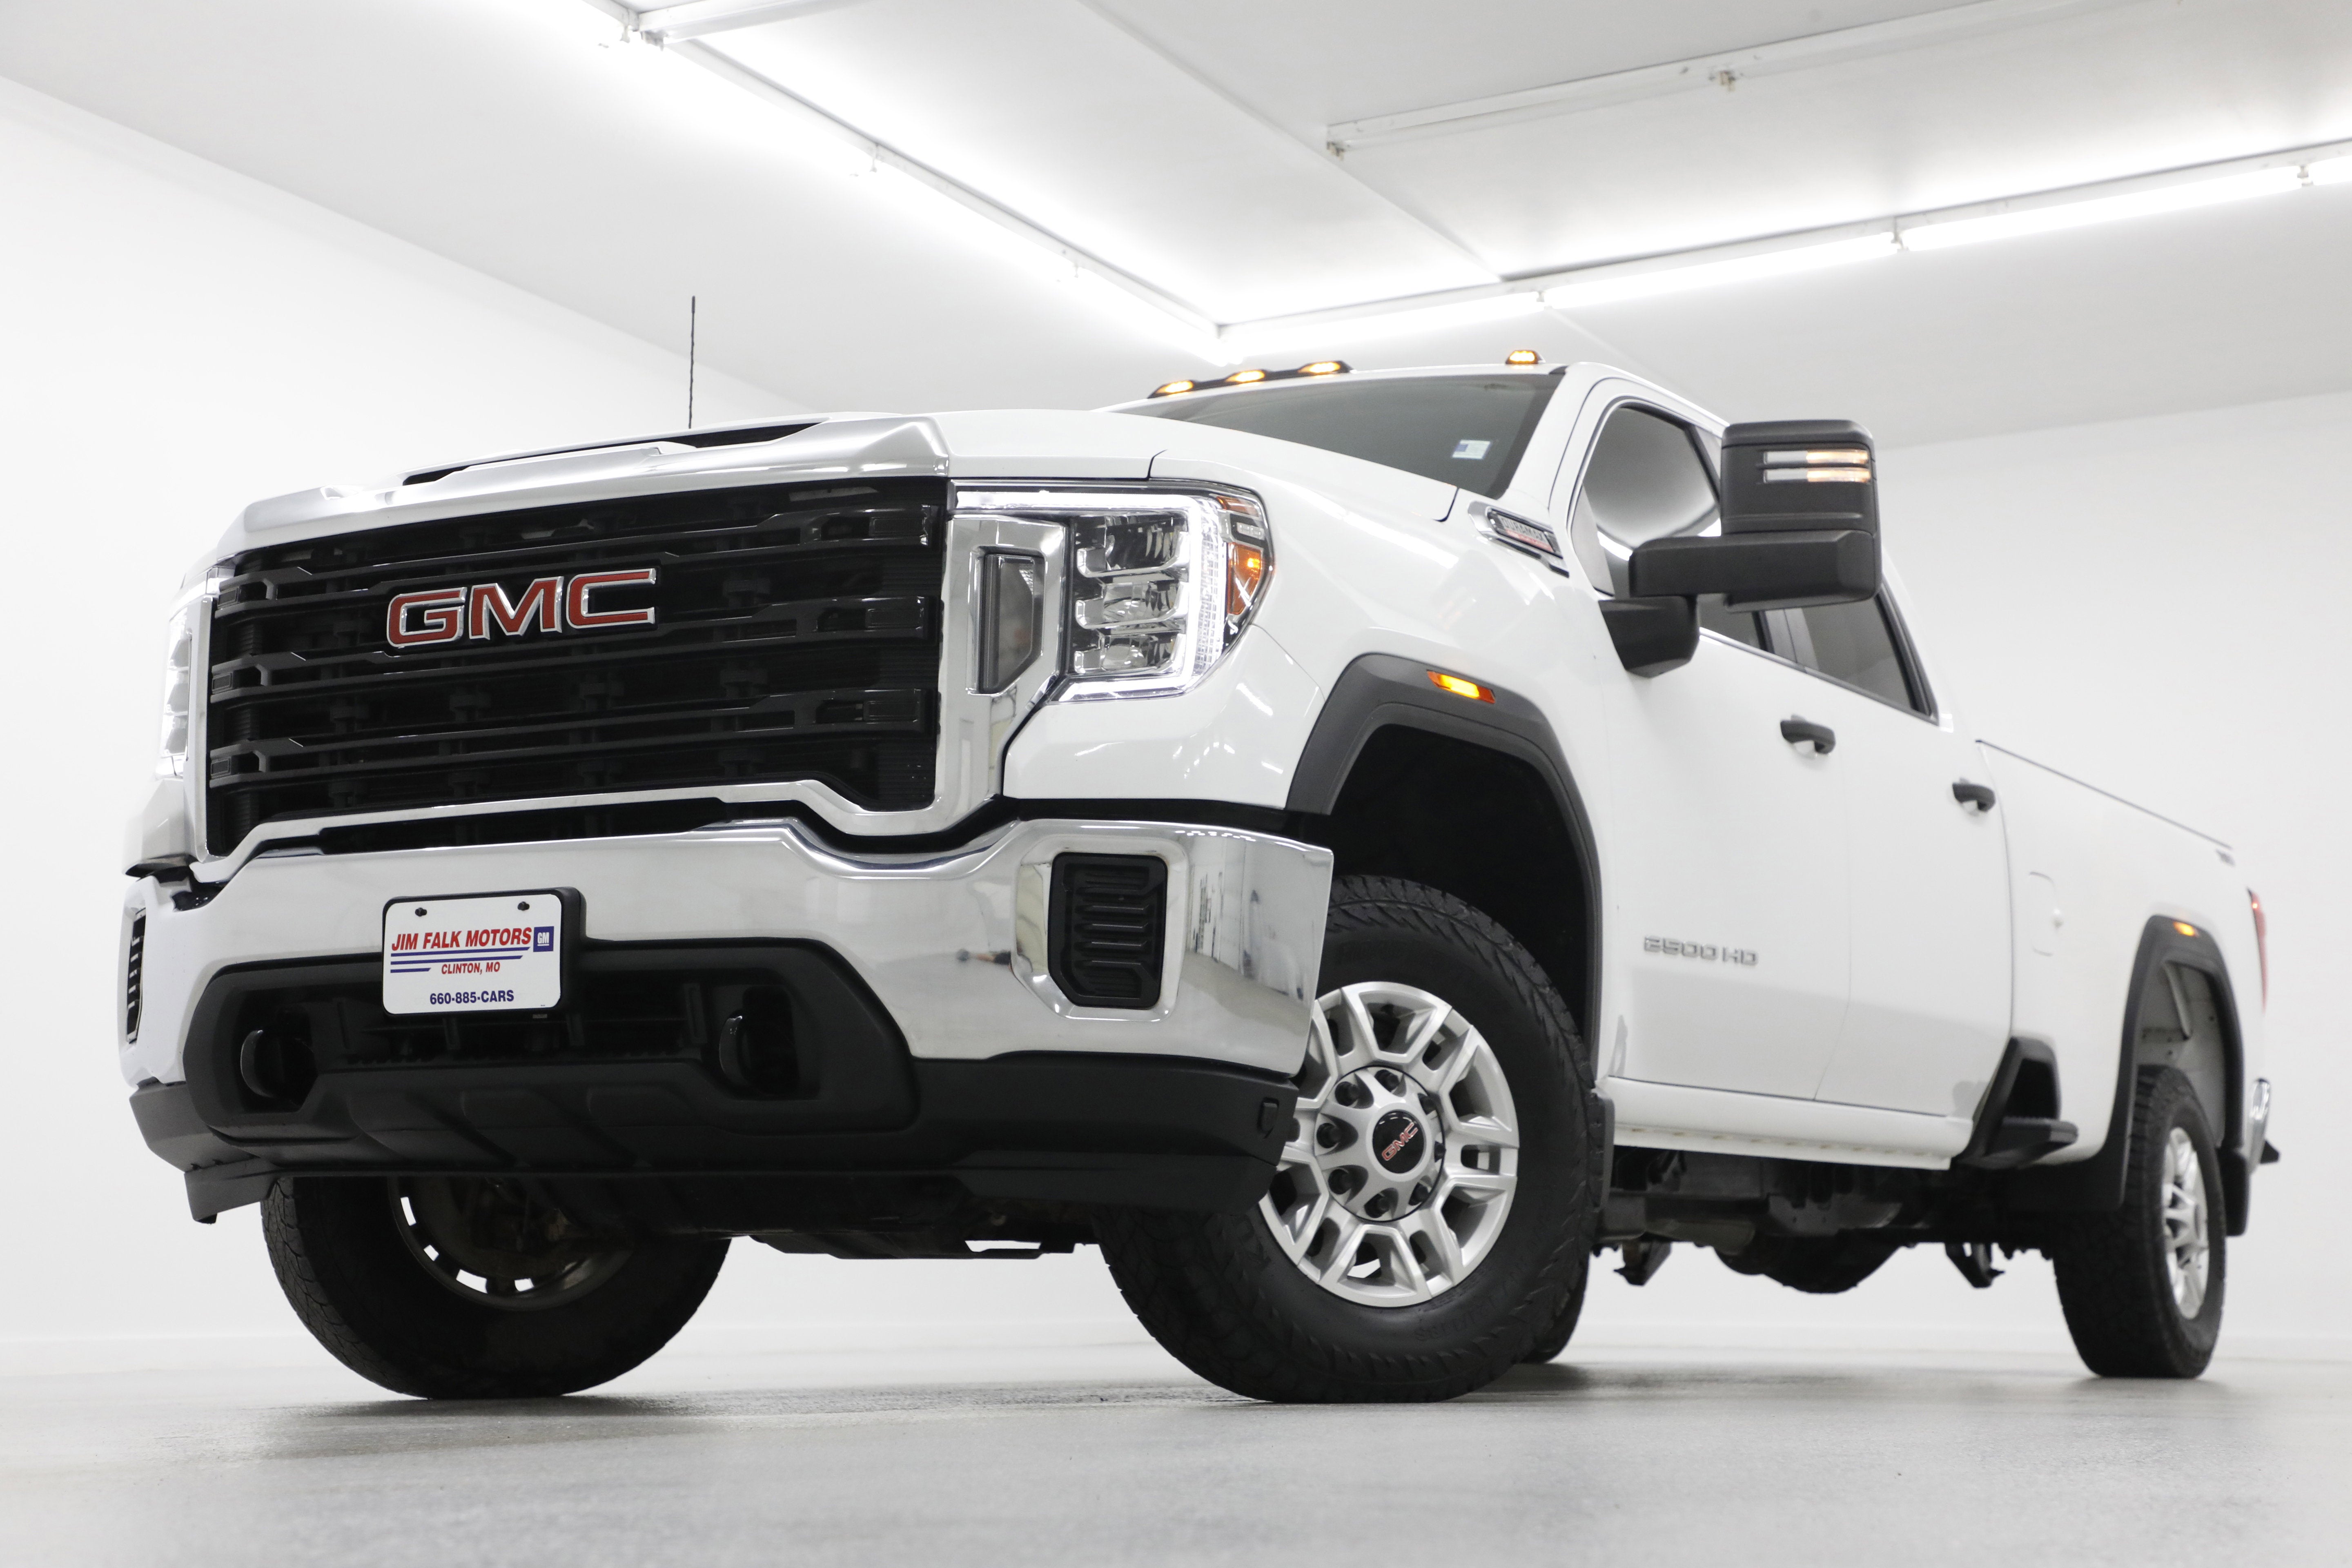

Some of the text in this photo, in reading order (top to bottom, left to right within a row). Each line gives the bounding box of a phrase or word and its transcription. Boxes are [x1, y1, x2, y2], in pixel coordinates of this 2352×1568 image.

[387, 568, 656, 648] GMC
[392, 927, 532, 951] JIM FALK MOTORS
[537, 932, 550, 946] GM
[441, 961, 501, 975] CLINTON, MO
[430, 989, 514, 1004] 660-885-CARS
[1381, 1122, 1419, 1160] GMC
